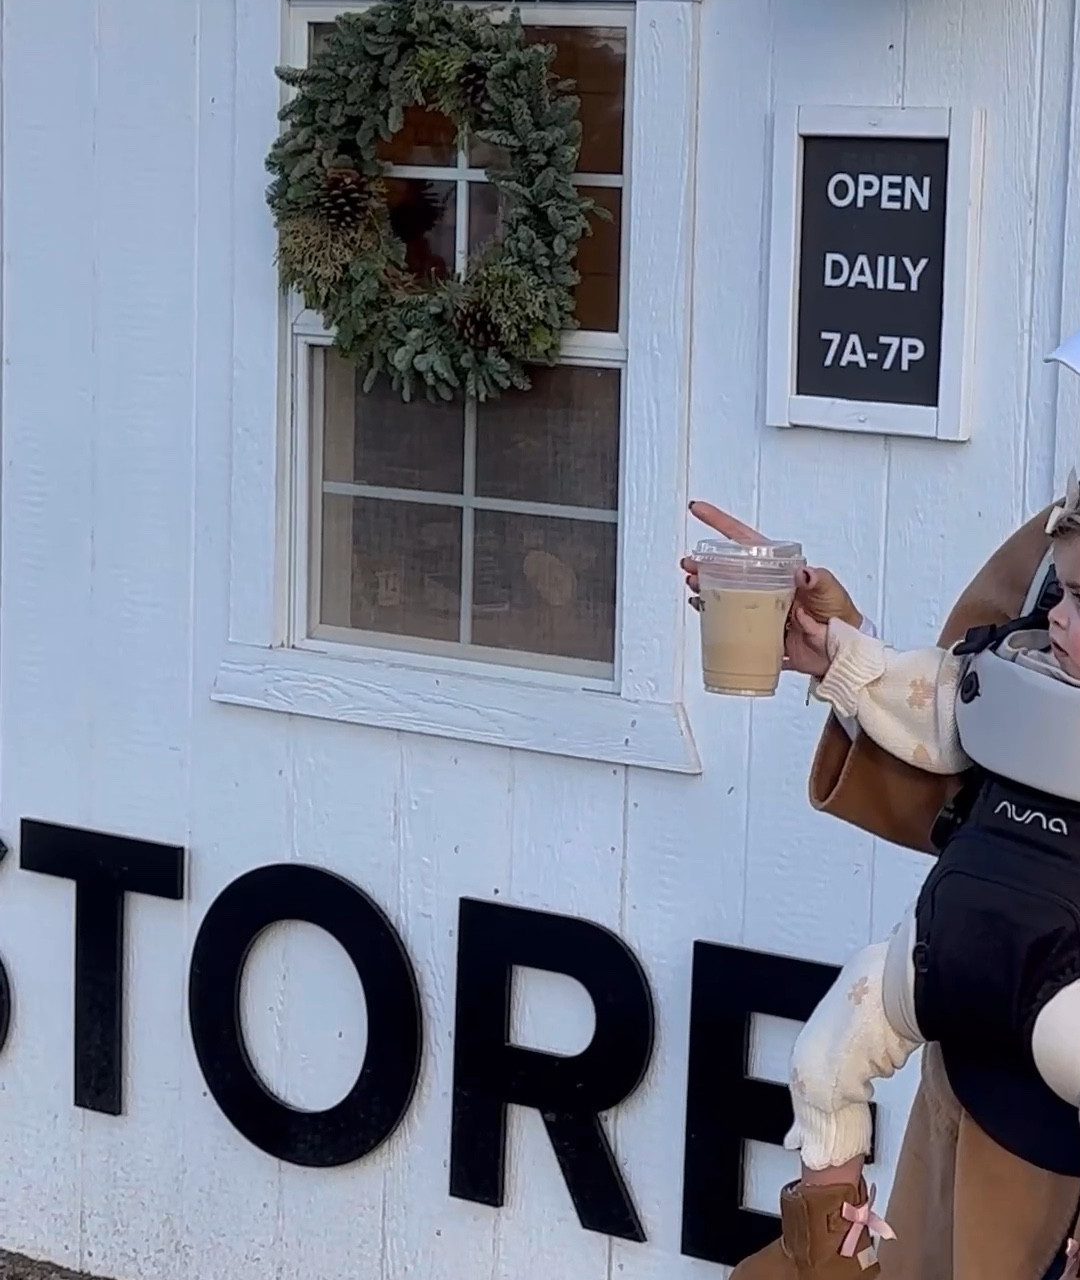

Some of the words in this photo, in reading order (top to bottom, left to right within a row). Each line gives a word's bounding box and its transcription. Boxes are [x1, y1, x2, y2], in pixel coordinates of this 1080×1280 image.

[827, 172, 931, 211] OPEN
[823, 252, 929, 292] DAILY
[820, 331, 925, 371] 7A-7P
[993, 800, 1069, 836] nuna
